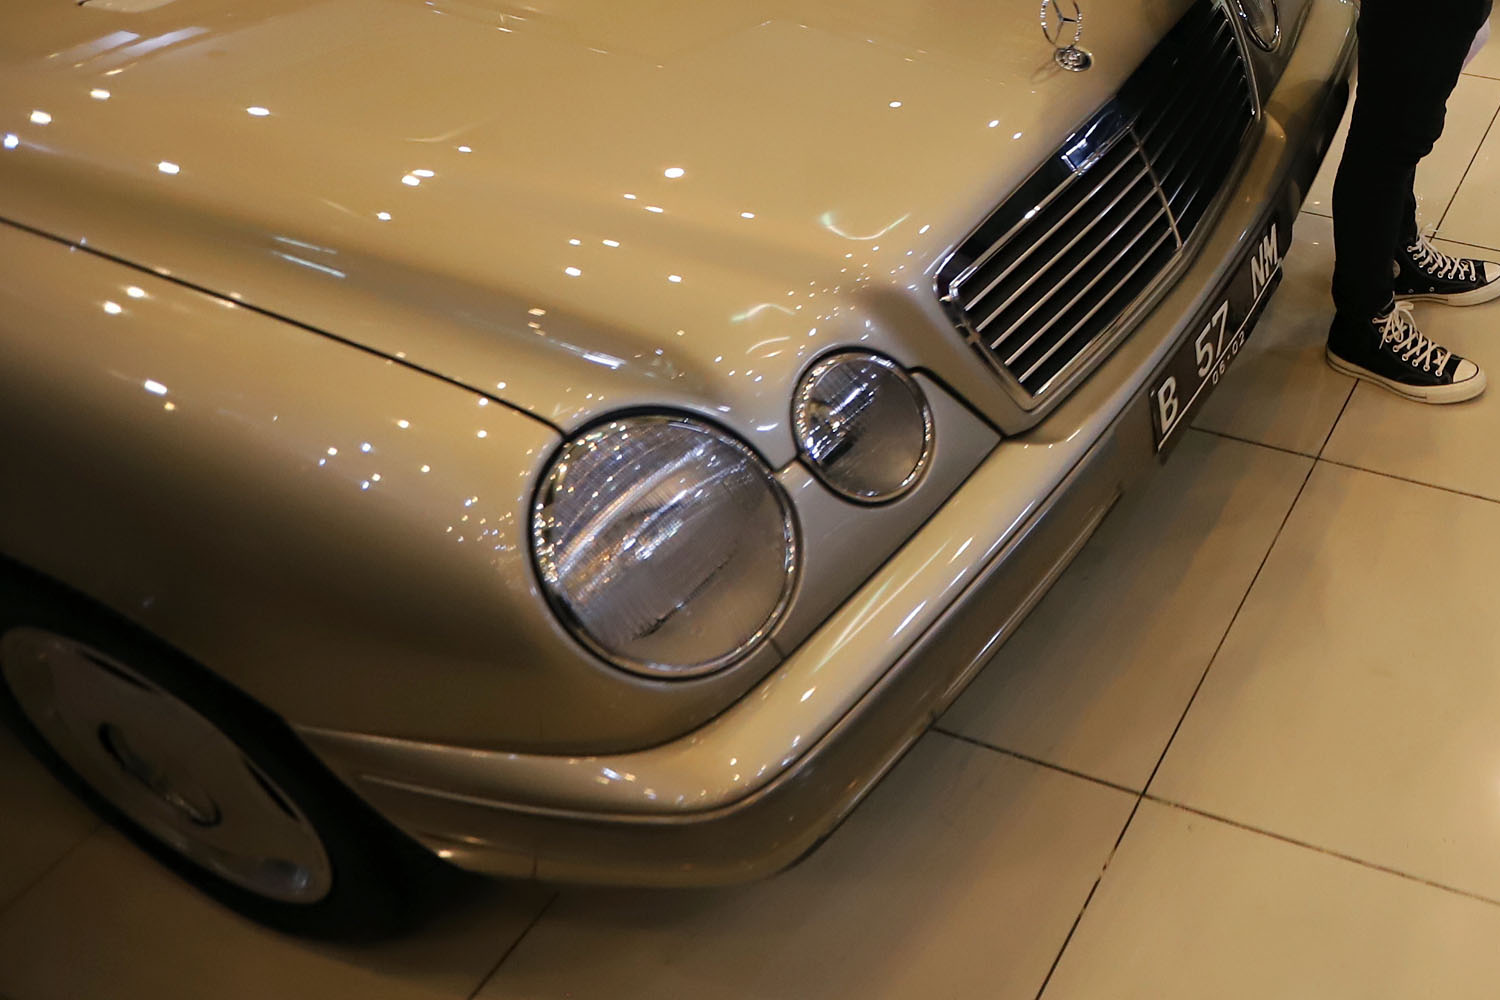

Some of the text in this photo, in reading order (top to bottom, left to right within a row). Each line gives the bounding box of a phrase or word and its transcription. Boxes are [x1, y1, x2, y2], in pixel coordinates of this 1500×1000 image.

[1157, 222, 1279, 436] B 57 NM
